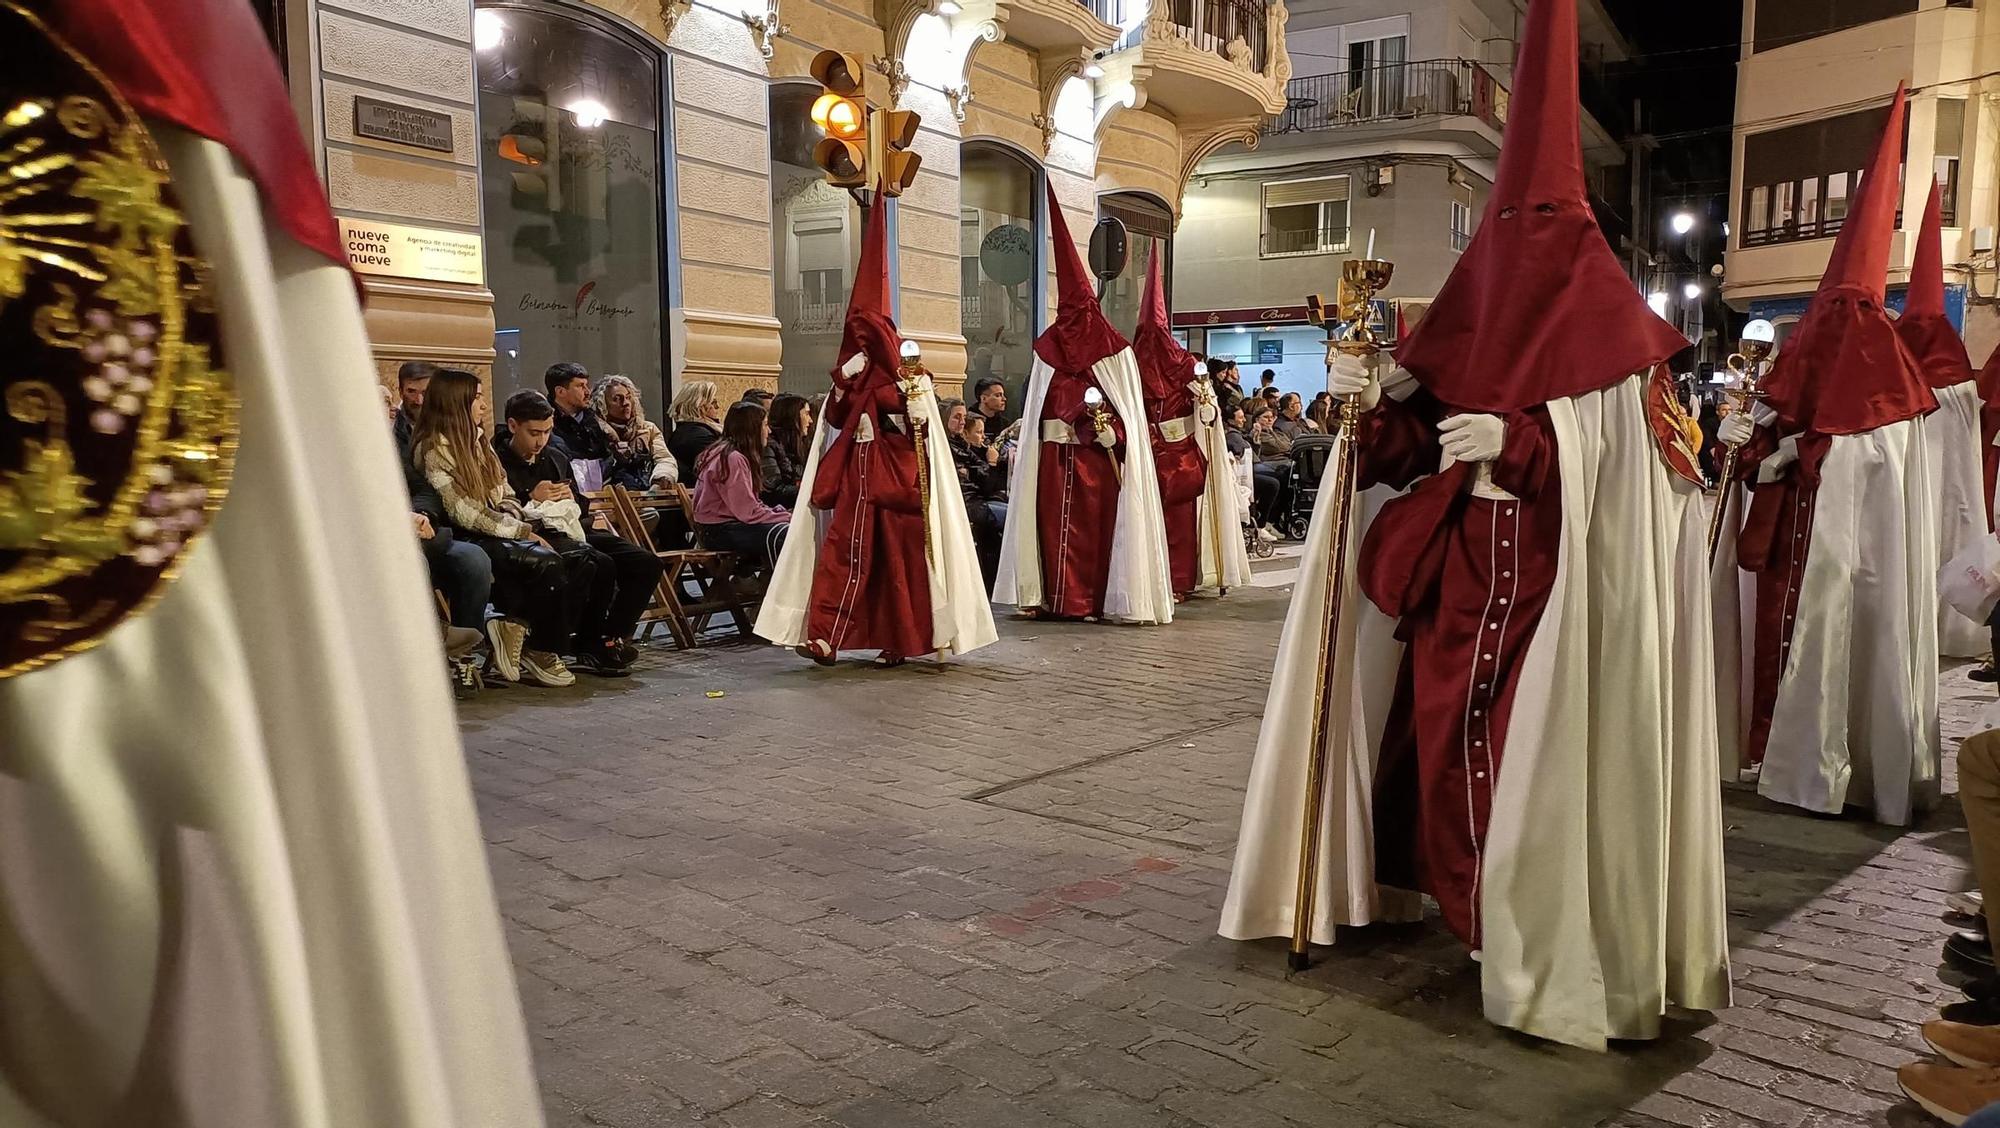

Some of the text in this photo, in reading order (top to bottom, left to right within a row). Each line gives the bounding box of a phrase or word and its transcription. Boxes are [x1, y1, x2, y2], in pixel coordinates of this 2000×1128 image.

[348, 229, 390, 243] nueve
[348, 241, 386, 254] coma
[349, 253, 391, 266] nueve
[1260, 309, 1292, 320] Bar
